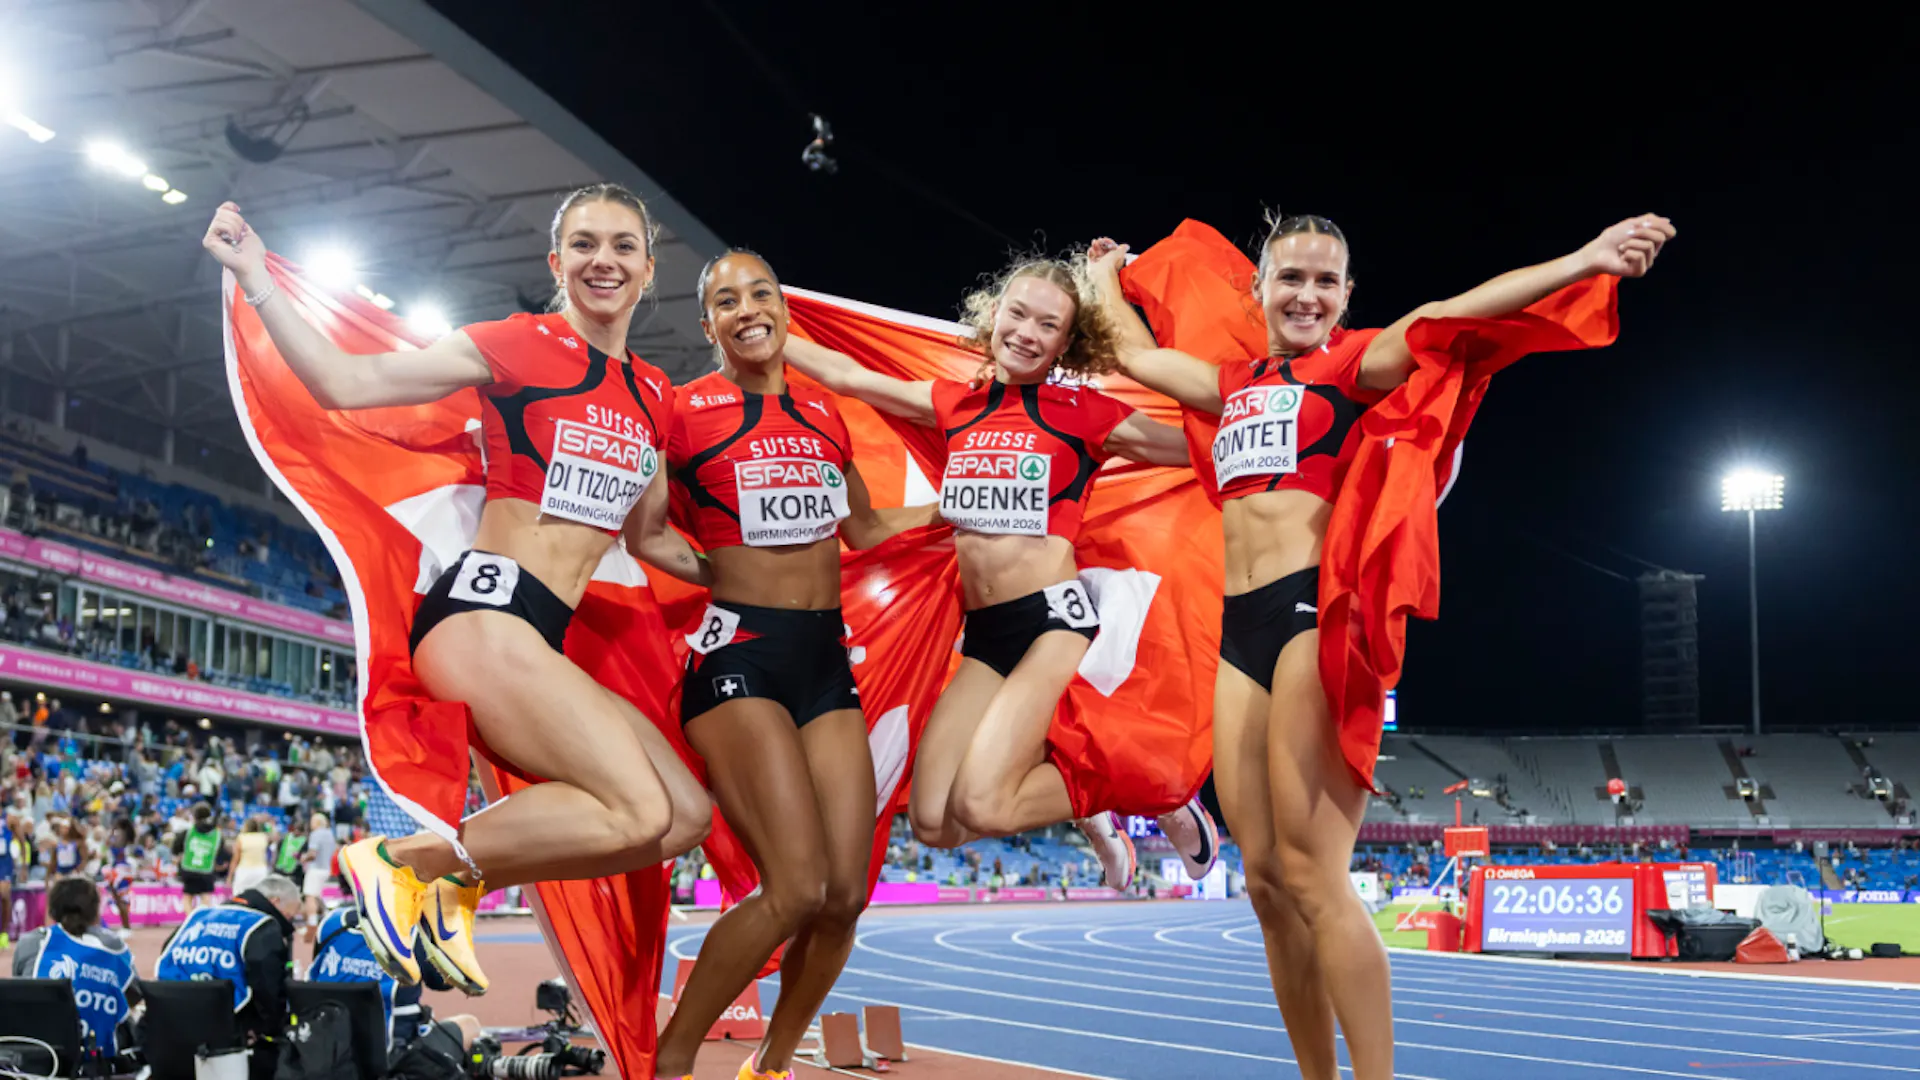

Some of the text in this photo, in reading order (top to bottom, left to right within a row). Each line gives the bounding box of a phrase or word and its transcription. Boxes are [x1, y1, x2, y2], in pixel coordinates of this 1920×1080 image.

[706, 394, 736, 406] UBS
[1222, 393, 1265, 421] PAR
[561, 428, 639, 469] SPAR
[948, 456, 1015, 476] SPAR
[1257, 456, 1289, 468] 2026
[548, 461, 572, 491] DI
[741, 464, 821, 487] SPAR
[760, 494, 836, 522] KORA
[943, 485, 1044, 512] HOENKE
[1012, 518, 1042, 530] 2026
[470, 564, 501, 594] 8
[701, 615, 723, 648] 8
[1497, 869, 1535, 880] OMEGA
[1493, 885, 1623, 915] 22:06:36
[1487, 928, 1625, 948] Birmingham 2026
[172, 945, 236, 969] PHOTO
[75, 989, 118, 1015] OTO
[720, 1005, 759, 1021] EGA
